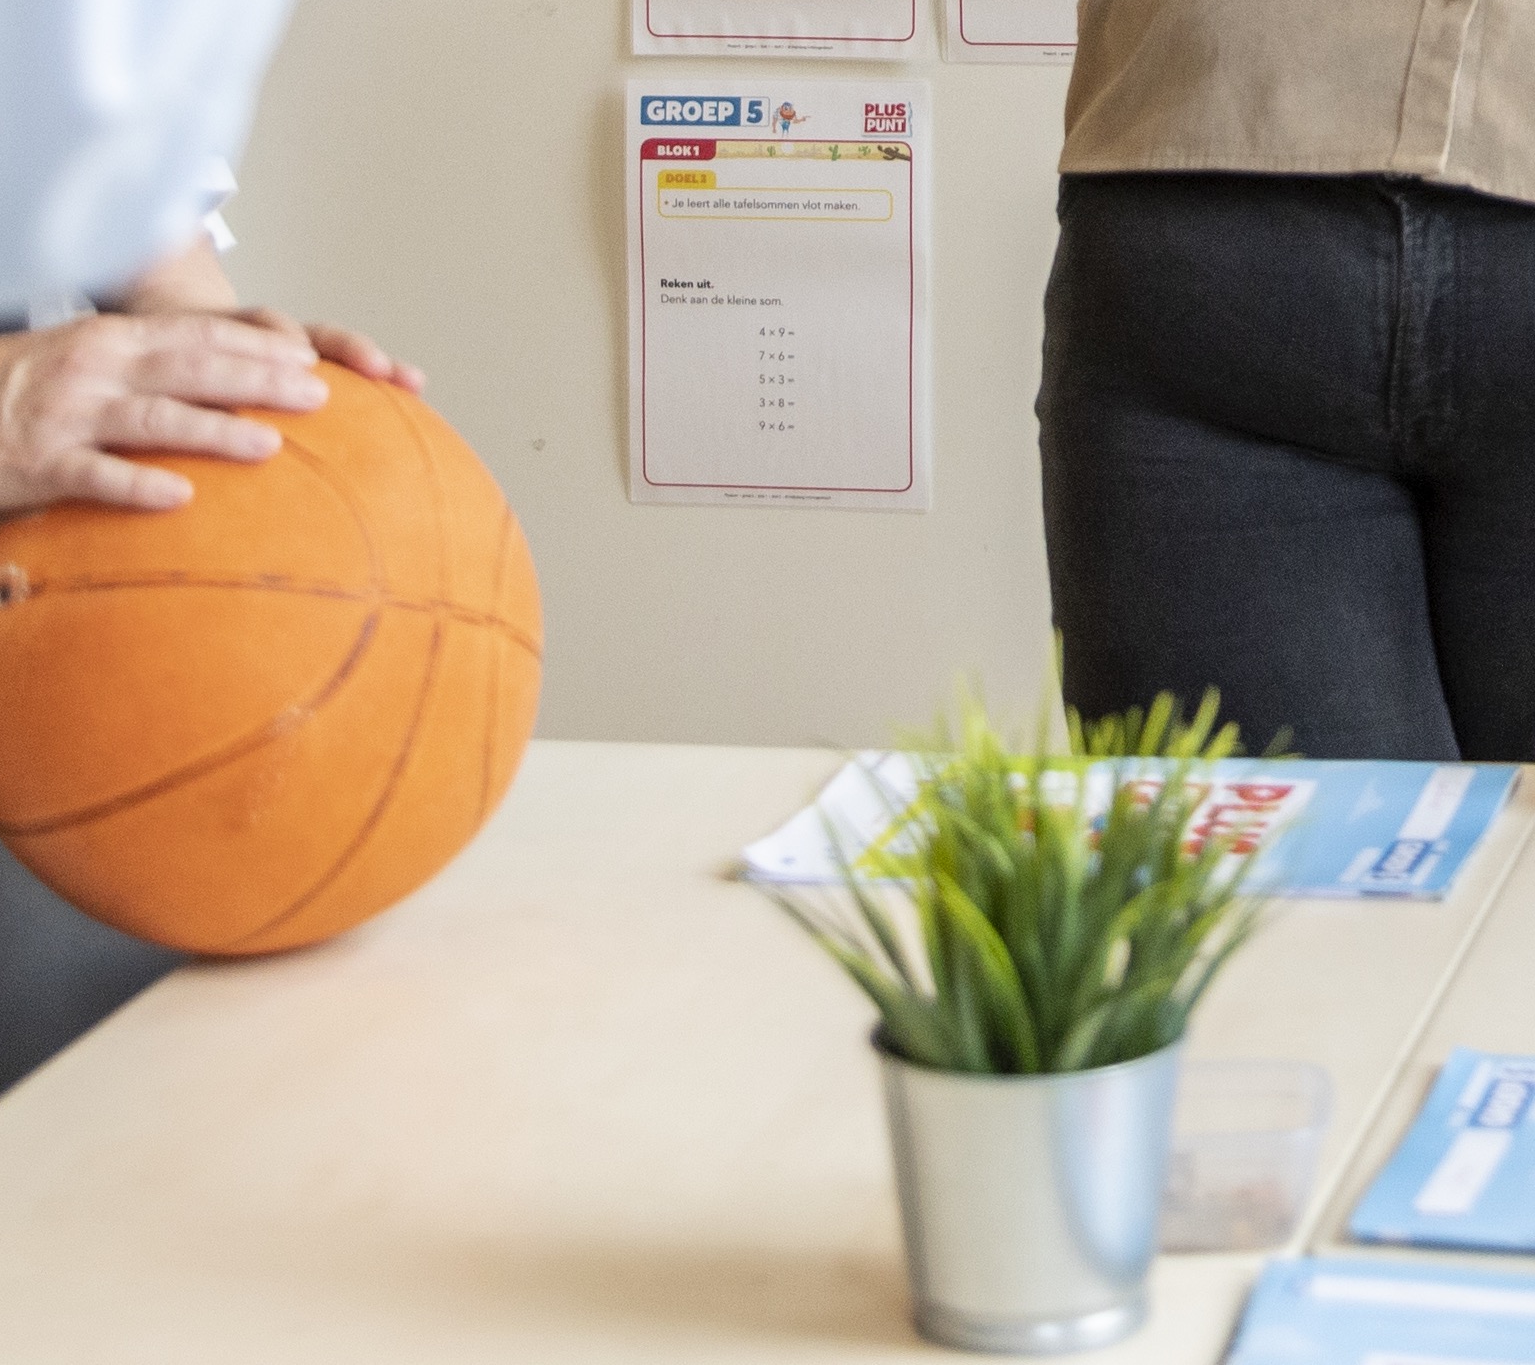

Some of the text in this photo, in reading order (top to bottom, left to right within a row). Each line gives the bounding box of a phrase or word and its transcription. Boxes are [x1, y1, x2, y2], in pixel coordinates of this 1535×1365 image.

[646, 100, 763, 124] GROEP 5
[864, 103, 906, 117] PLUS
[865, 120, 906, 134] PUNT
[671, 198, 860, 211] Je leert alle tafelsommen vlot maken.
[660, 278, 714, 289] Reken uit.
